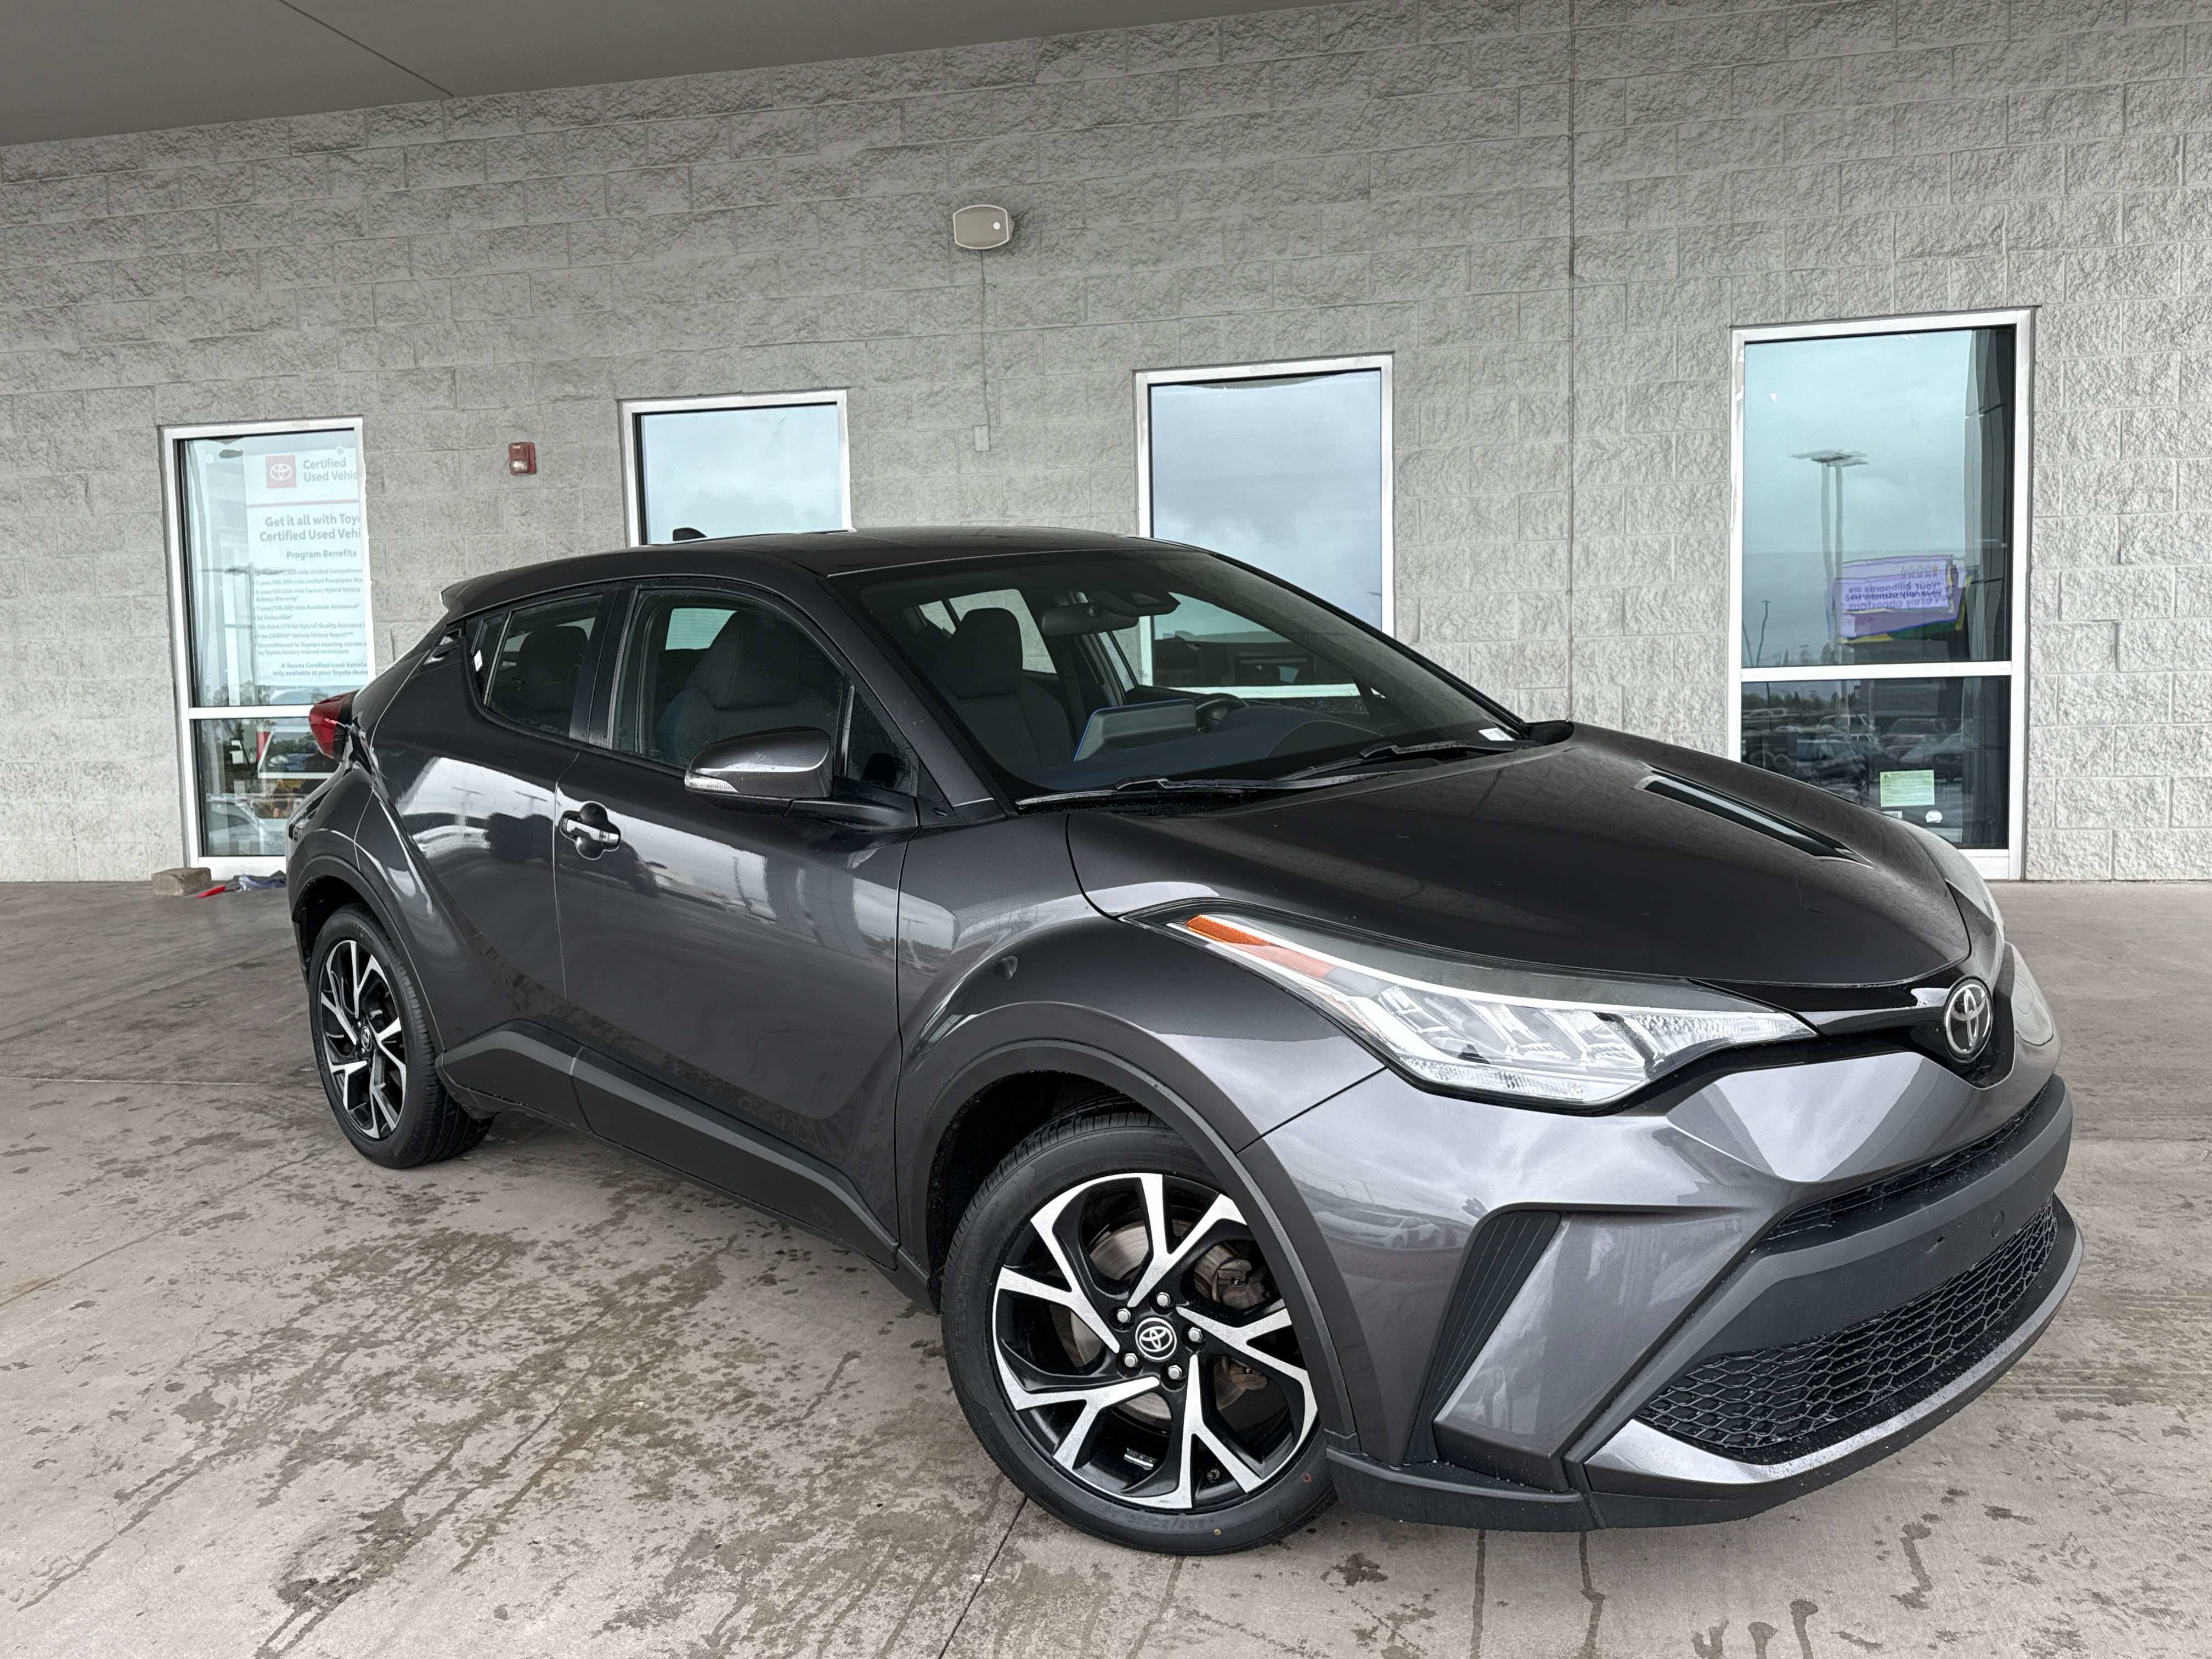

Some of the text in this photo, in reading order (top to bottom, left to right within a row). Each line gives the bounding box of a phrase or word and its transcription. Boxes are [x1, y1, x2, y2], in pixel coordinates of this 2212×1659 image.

[303, 457, 346, 469] Certified
[303, 471, 329, 482] Used
[265, 516, 285, 527] Get
[287, 515, 295, 526] it
[297, 515, 310, 525] all
[313, 514, 336, 524] with
[259, 529, 306, 541] Certified
[308, 529, 335, 539] Used
[286, 548, 357, 560] Program Benefits
